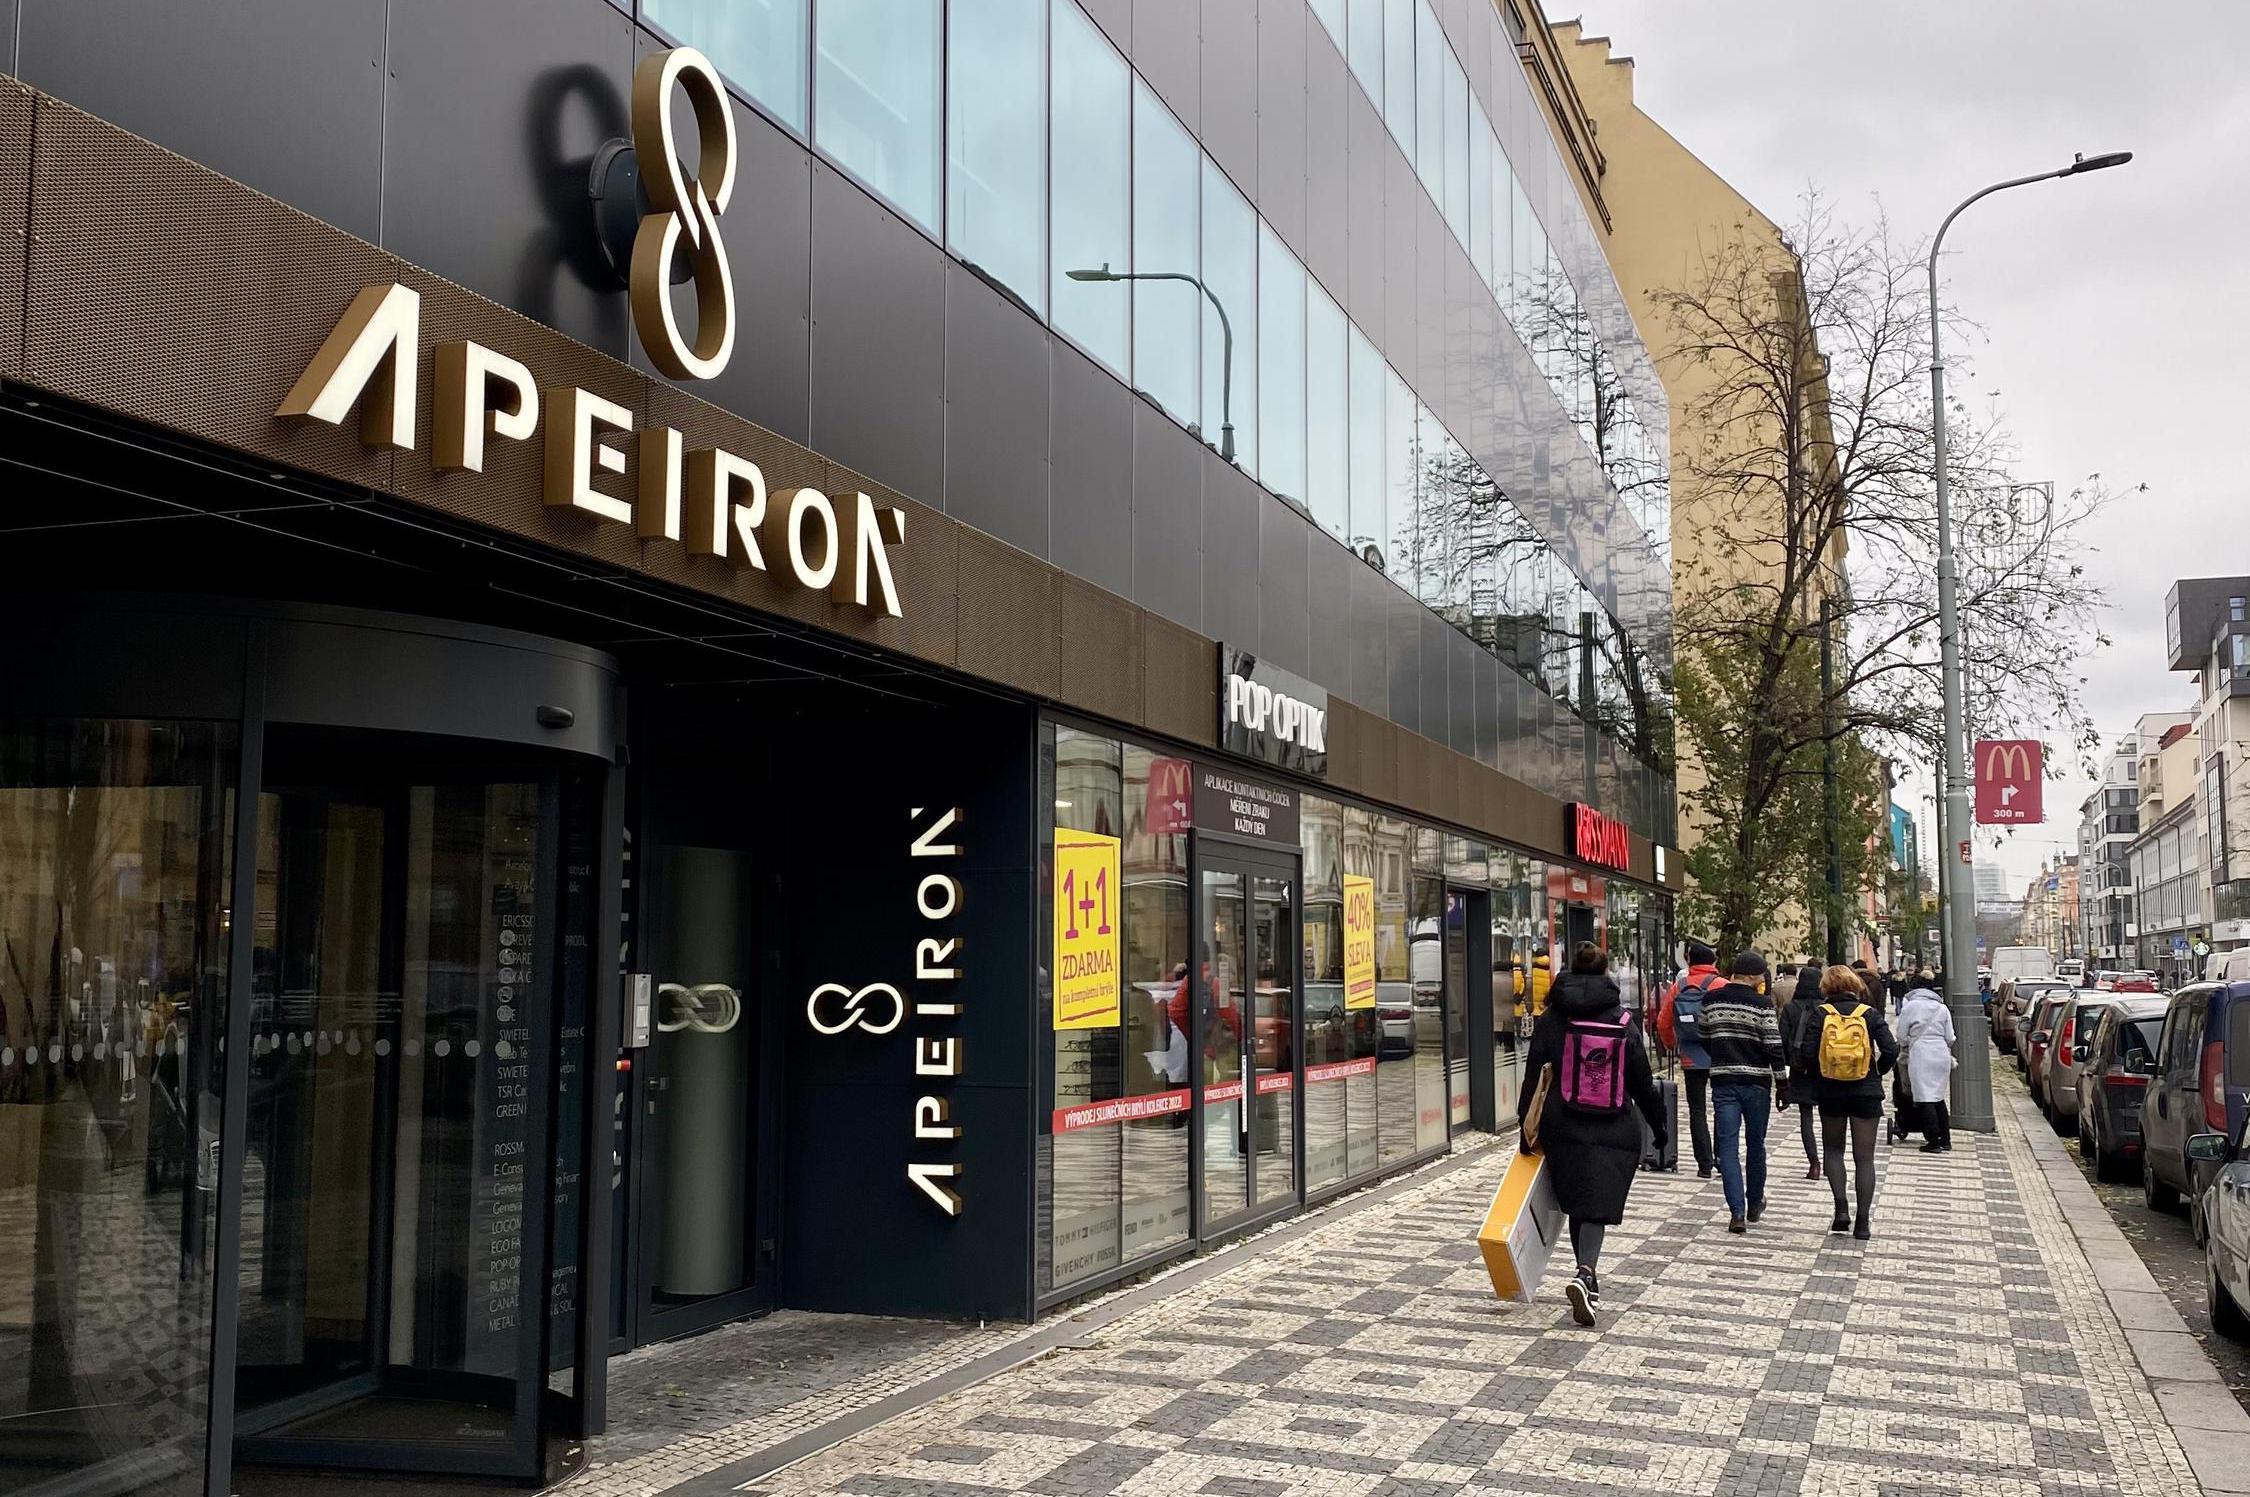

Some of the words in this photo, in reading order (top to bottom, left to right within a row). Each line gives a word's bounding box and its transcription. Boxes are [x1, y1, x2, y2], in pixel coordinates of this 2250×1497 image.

[278, 282, 905, 618] APEIRON
[1230, 673, 1272, 732] POP
[1273, 693, 1327, 753] OPTIK
[1204, 773, 1233, 794] APLIKACE
[1230, 796, 1251, 816] MĚŘENÍ
[1252, 803, 1270, 819] ZRAKU
[1993, 809, 2012, 818] 300
[2015, 810, 2025, 818] m
[1234, 815, 1253, 833] KAŽDÝ
[1254, 821, 1266, 835] DEN
[1576, 801, 1630, 872] ROSSMANN
[1063, 867, 1111, 939] 1+1
[1347, 891, 1371, 933] 40%
[1063, 949, 1113, 981] ZDARMA
[1348, 940, 1372, 967] SLEVA
[908, 806, 964, 1217] APEIRON
[1065, 1108, 1096, 1129] VÝPRODEJ
[1096, 1101, 1131, 1120] SLUNEČNÍCH
[1131, 1098, 1147, 1116] BRÝLÍ
[1147, 1098, 1168, 1114] KOLEKCE
[494, 1141, 525, 1157] ROSSM
[1055, 1230, 1082, 1246] TOMMY
[1089, 1217, 1117, 1235] HILFIGER
[1055, 1253, 1094, 1277] GIVENCHY
[1097, 1246, 1116, 1262] FOSSIL
